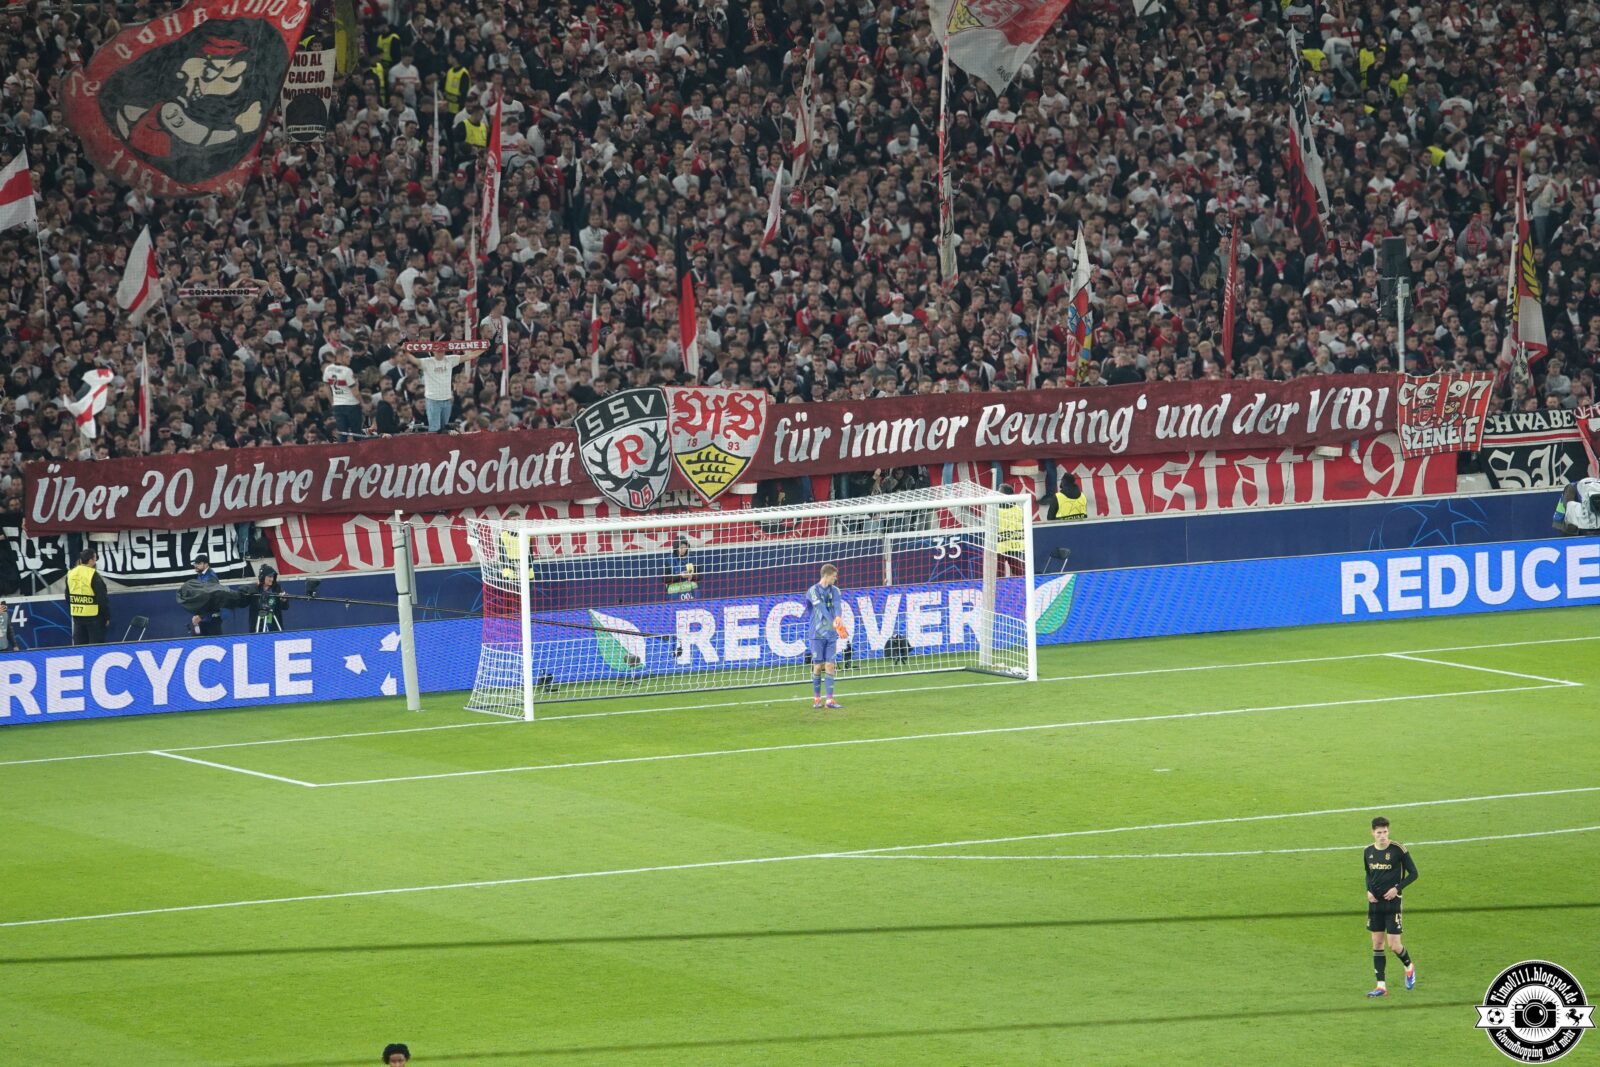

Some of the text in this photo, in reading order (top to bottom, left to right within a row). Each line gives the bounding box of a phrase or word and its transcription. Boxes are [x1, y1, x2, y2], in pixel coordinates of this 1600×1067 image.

[293, 53, 322, 67] NO AL
[288, 70, 325, 84] CALCIO
[188, 288, 250, 296] COMMANDO
[406, 341, 488, 351] CC 97 SZENE E
[1399, 380, 1492, 405] CC 97
[585, 394, 655, 437] SSV
[687, 438, 741, 451] 18 93
[1401, 415, 1481, 450] SZENE E
[31, 463, 129, 524] Über
[136, 467, 194, 518] 20
[199, 461, 313, 519] Jahre
[321, 441, 575, 502] Freundschaft
[773, 411, 831, 465] für
[838, 411, 969, 460] immer
[1154, 392, 1232, 440] und
[1232, 392, 1300, 436] der
[1306, 386, 1391, 434] VfB!
[614, 434, 648, 475] R
[631, 484, 653, 506] 05
[932, 536, 962, 560] 35
[1340, 543, 1600, 616] REDUCE
[0, 638, 314, 718] RECYCLE
